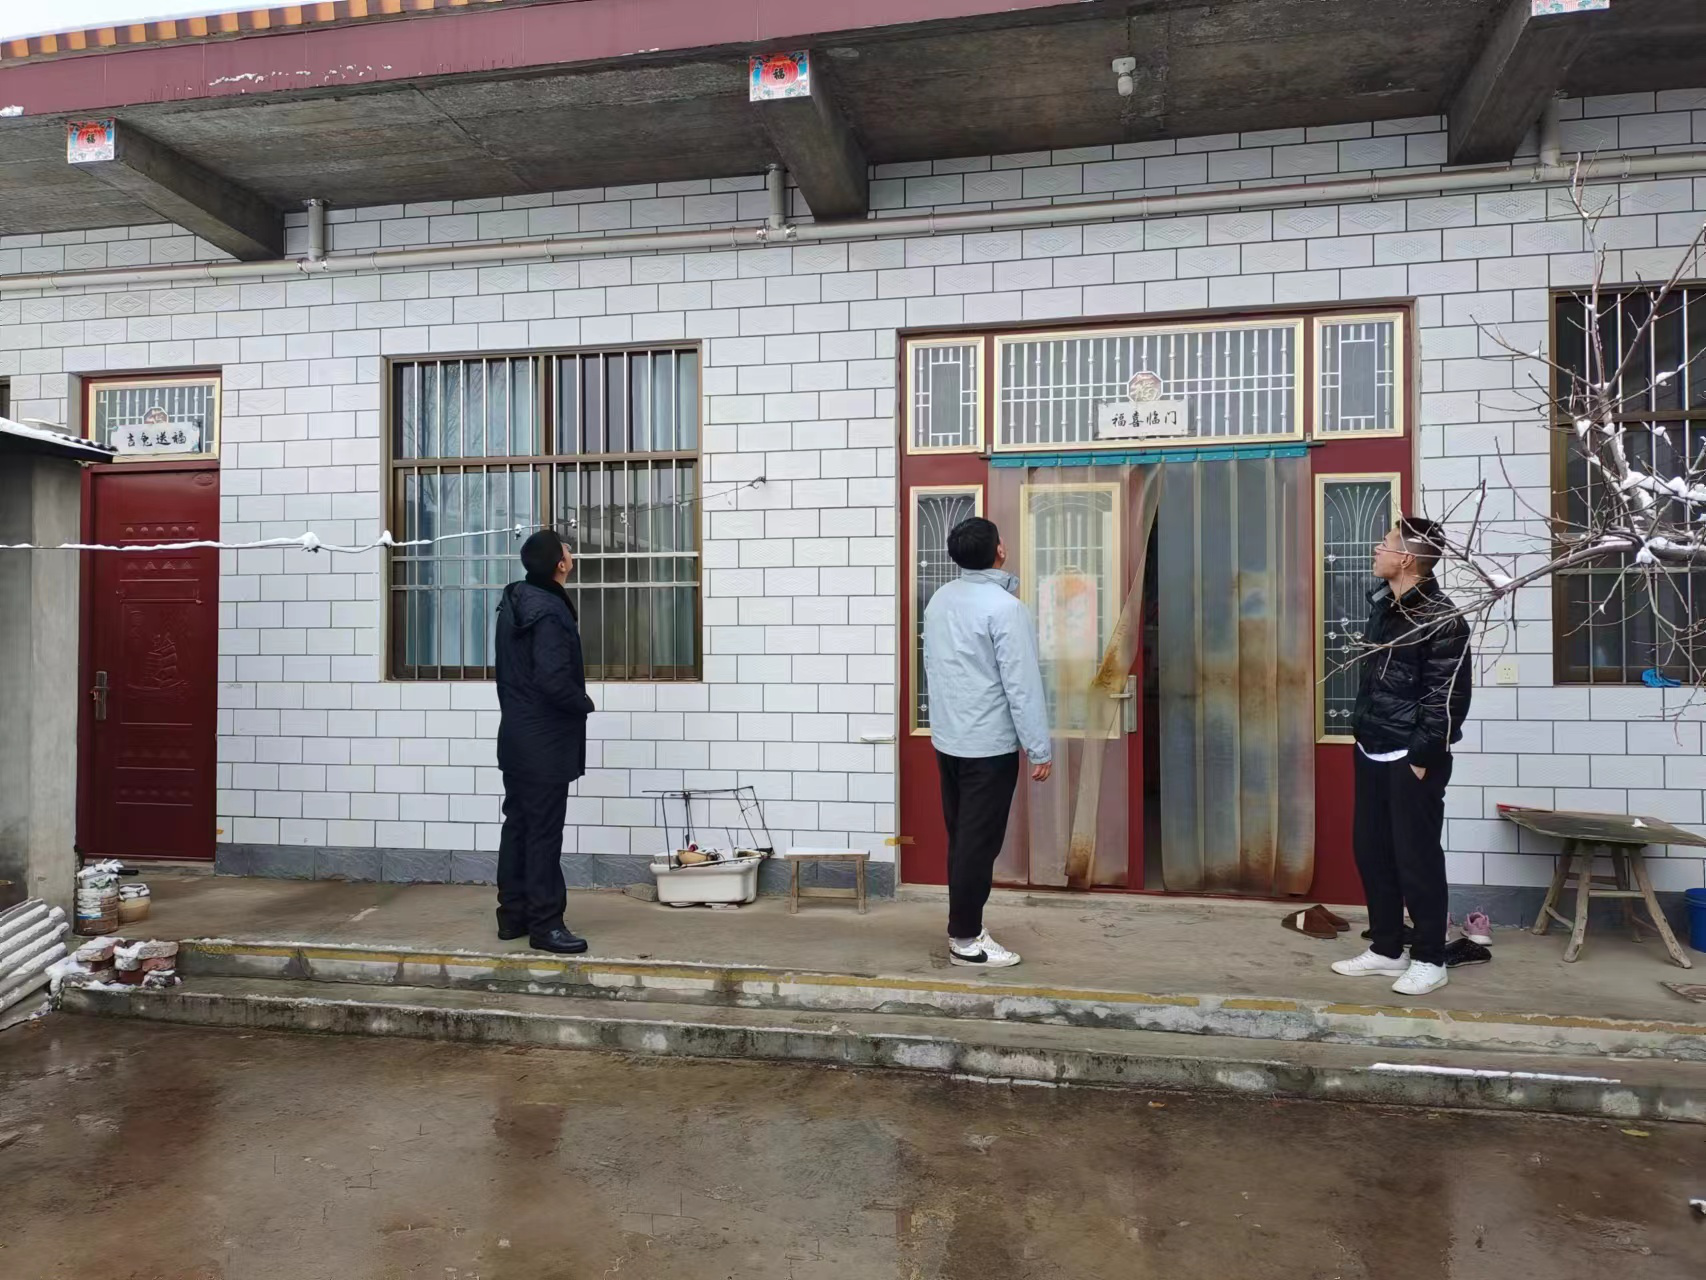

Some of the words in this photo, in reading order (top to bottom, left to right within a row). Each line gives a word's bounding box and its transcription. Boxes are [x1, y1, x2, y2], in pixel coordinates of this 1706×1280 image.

[773, 68, 785, 80] 福
[86, 133, 96, 144] 福
[1111, 410, 1177, 428] 福喜临门
